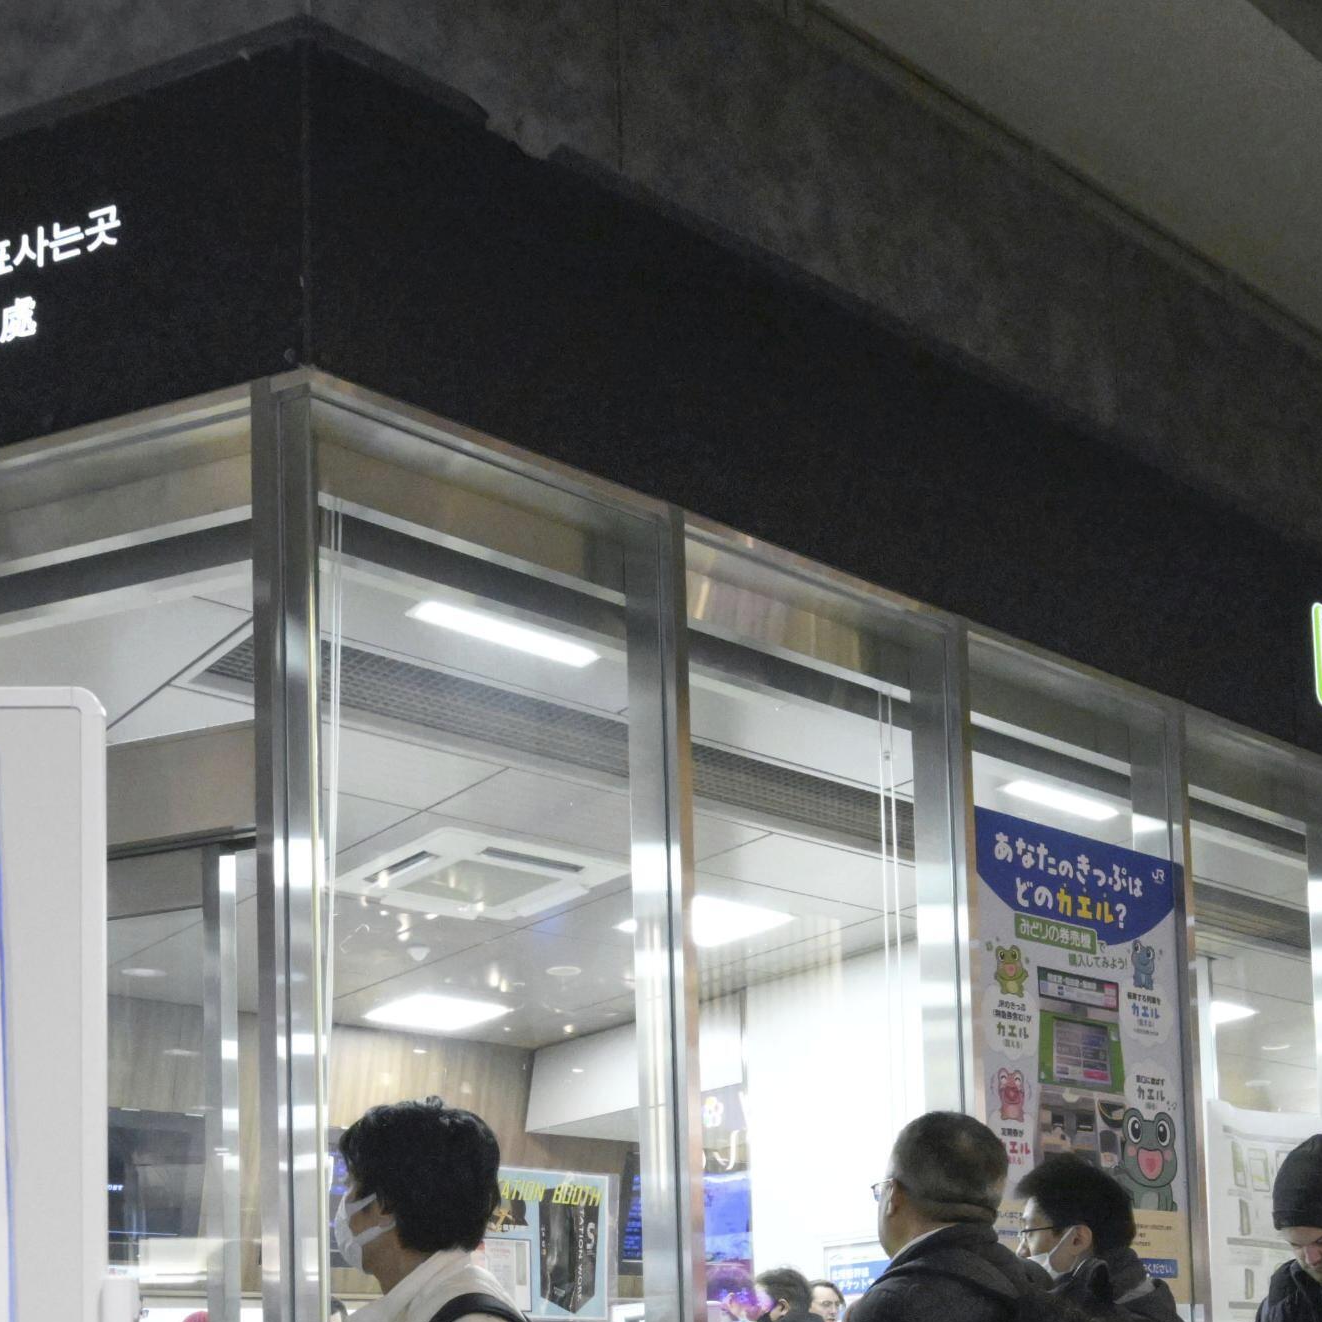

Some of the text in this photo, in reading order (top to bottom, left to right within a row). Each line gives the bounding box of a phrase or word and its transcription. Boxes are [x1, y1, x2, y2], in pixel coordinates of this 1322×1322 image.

[993, 832, 1143, 897] あなたのきっぷは
[1015, 876, 1127, 929] どのカエル?
[996, 1021, 1029, 1039] カエル
[552, 1184, 600, 1207] BOOTH
